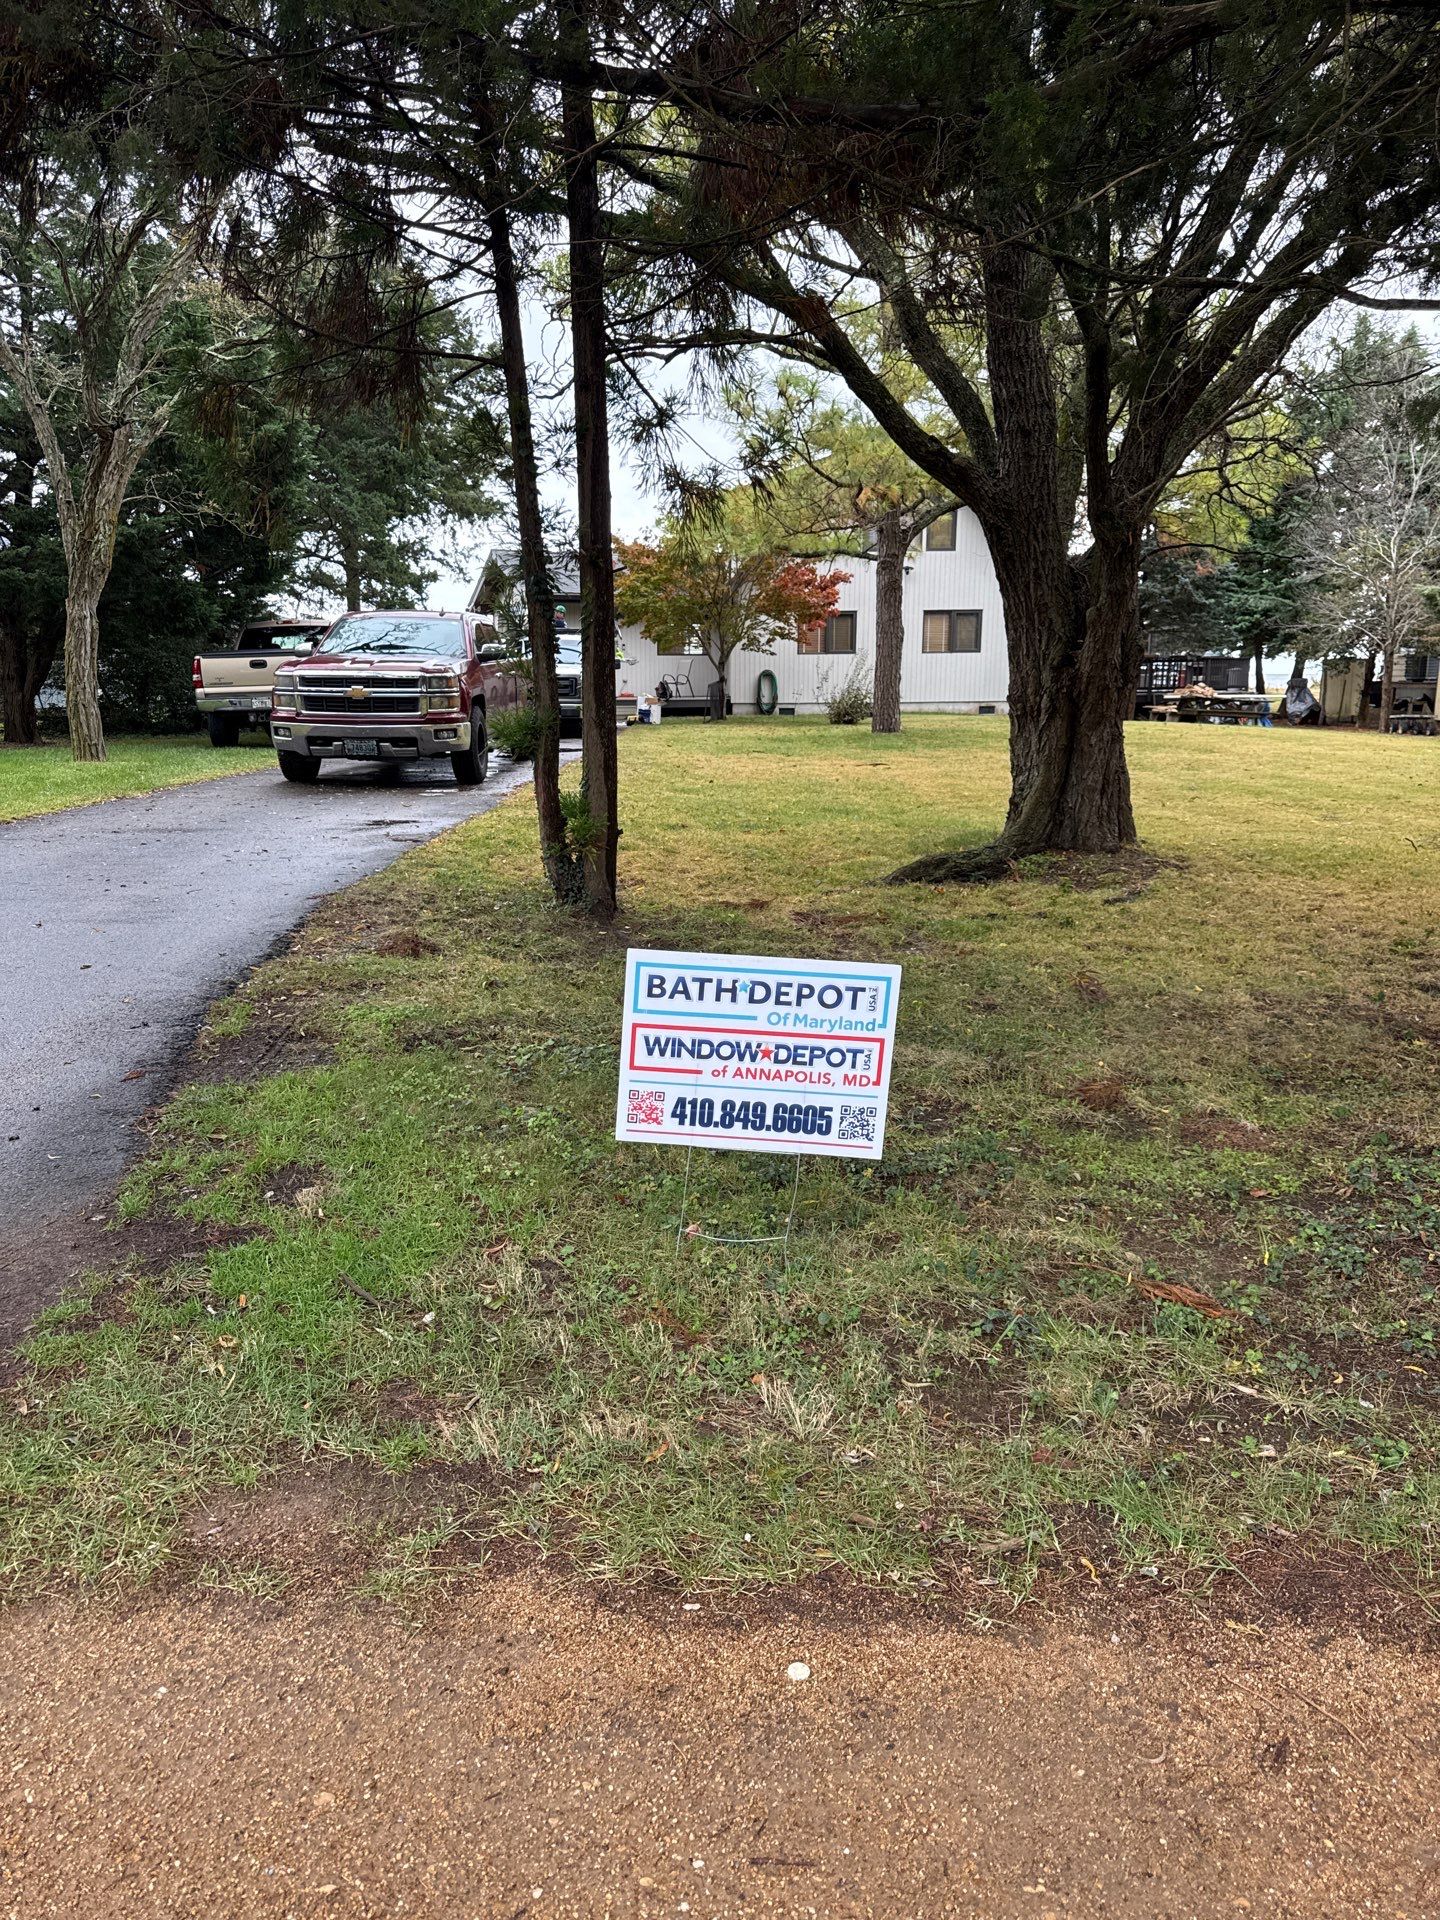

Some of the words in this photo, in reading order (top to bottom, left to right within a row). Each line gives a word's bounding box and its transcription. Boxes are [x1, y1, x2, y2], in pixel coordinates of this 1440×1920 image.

[646, 974, 738, 1004] BATH
[748, 980, 867, 1011] DEPOT
[868, 994, 877, 1012] USA
[767, 1011, 791, 1027] Of
[793, 1013, 876, 1033] Maryland
[643, 1035, 763, 1064] WINDOW
[773, 1043, 865, 1070] DEPOT
[863, 1053, 871, 1071] USA
[711, 1065, 729, 1079] of
[732, 1067, 835, 1088] ANNAPOLIS,
[842, 1073, 872, 1087] MD
[671, 1097, 834, 1136] 410.849.6605
